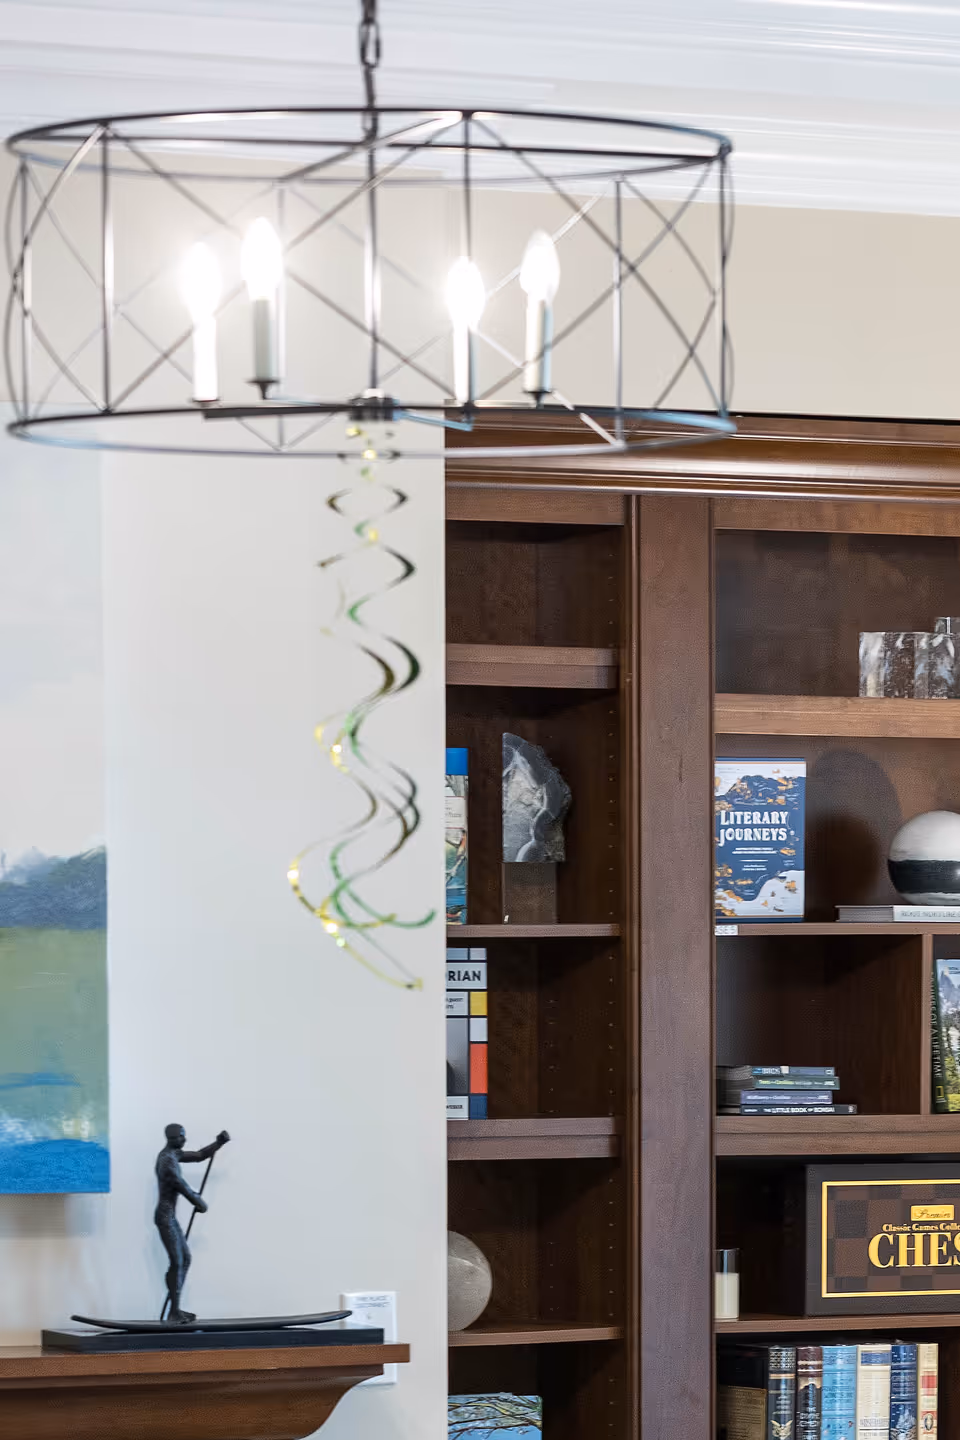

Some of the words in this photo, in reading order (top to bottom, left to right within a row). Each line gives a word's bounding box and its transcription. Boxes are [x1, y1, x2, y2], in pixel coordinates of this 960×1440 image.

[719, 809, 789, 826] LITERARY
[718, 827, 788, 847] JOURNEYS
[447, 970, 481, 982] RIAN
[882, 1223, 911, 1232] Classic
[912, 1223, 939, 1231] Games
